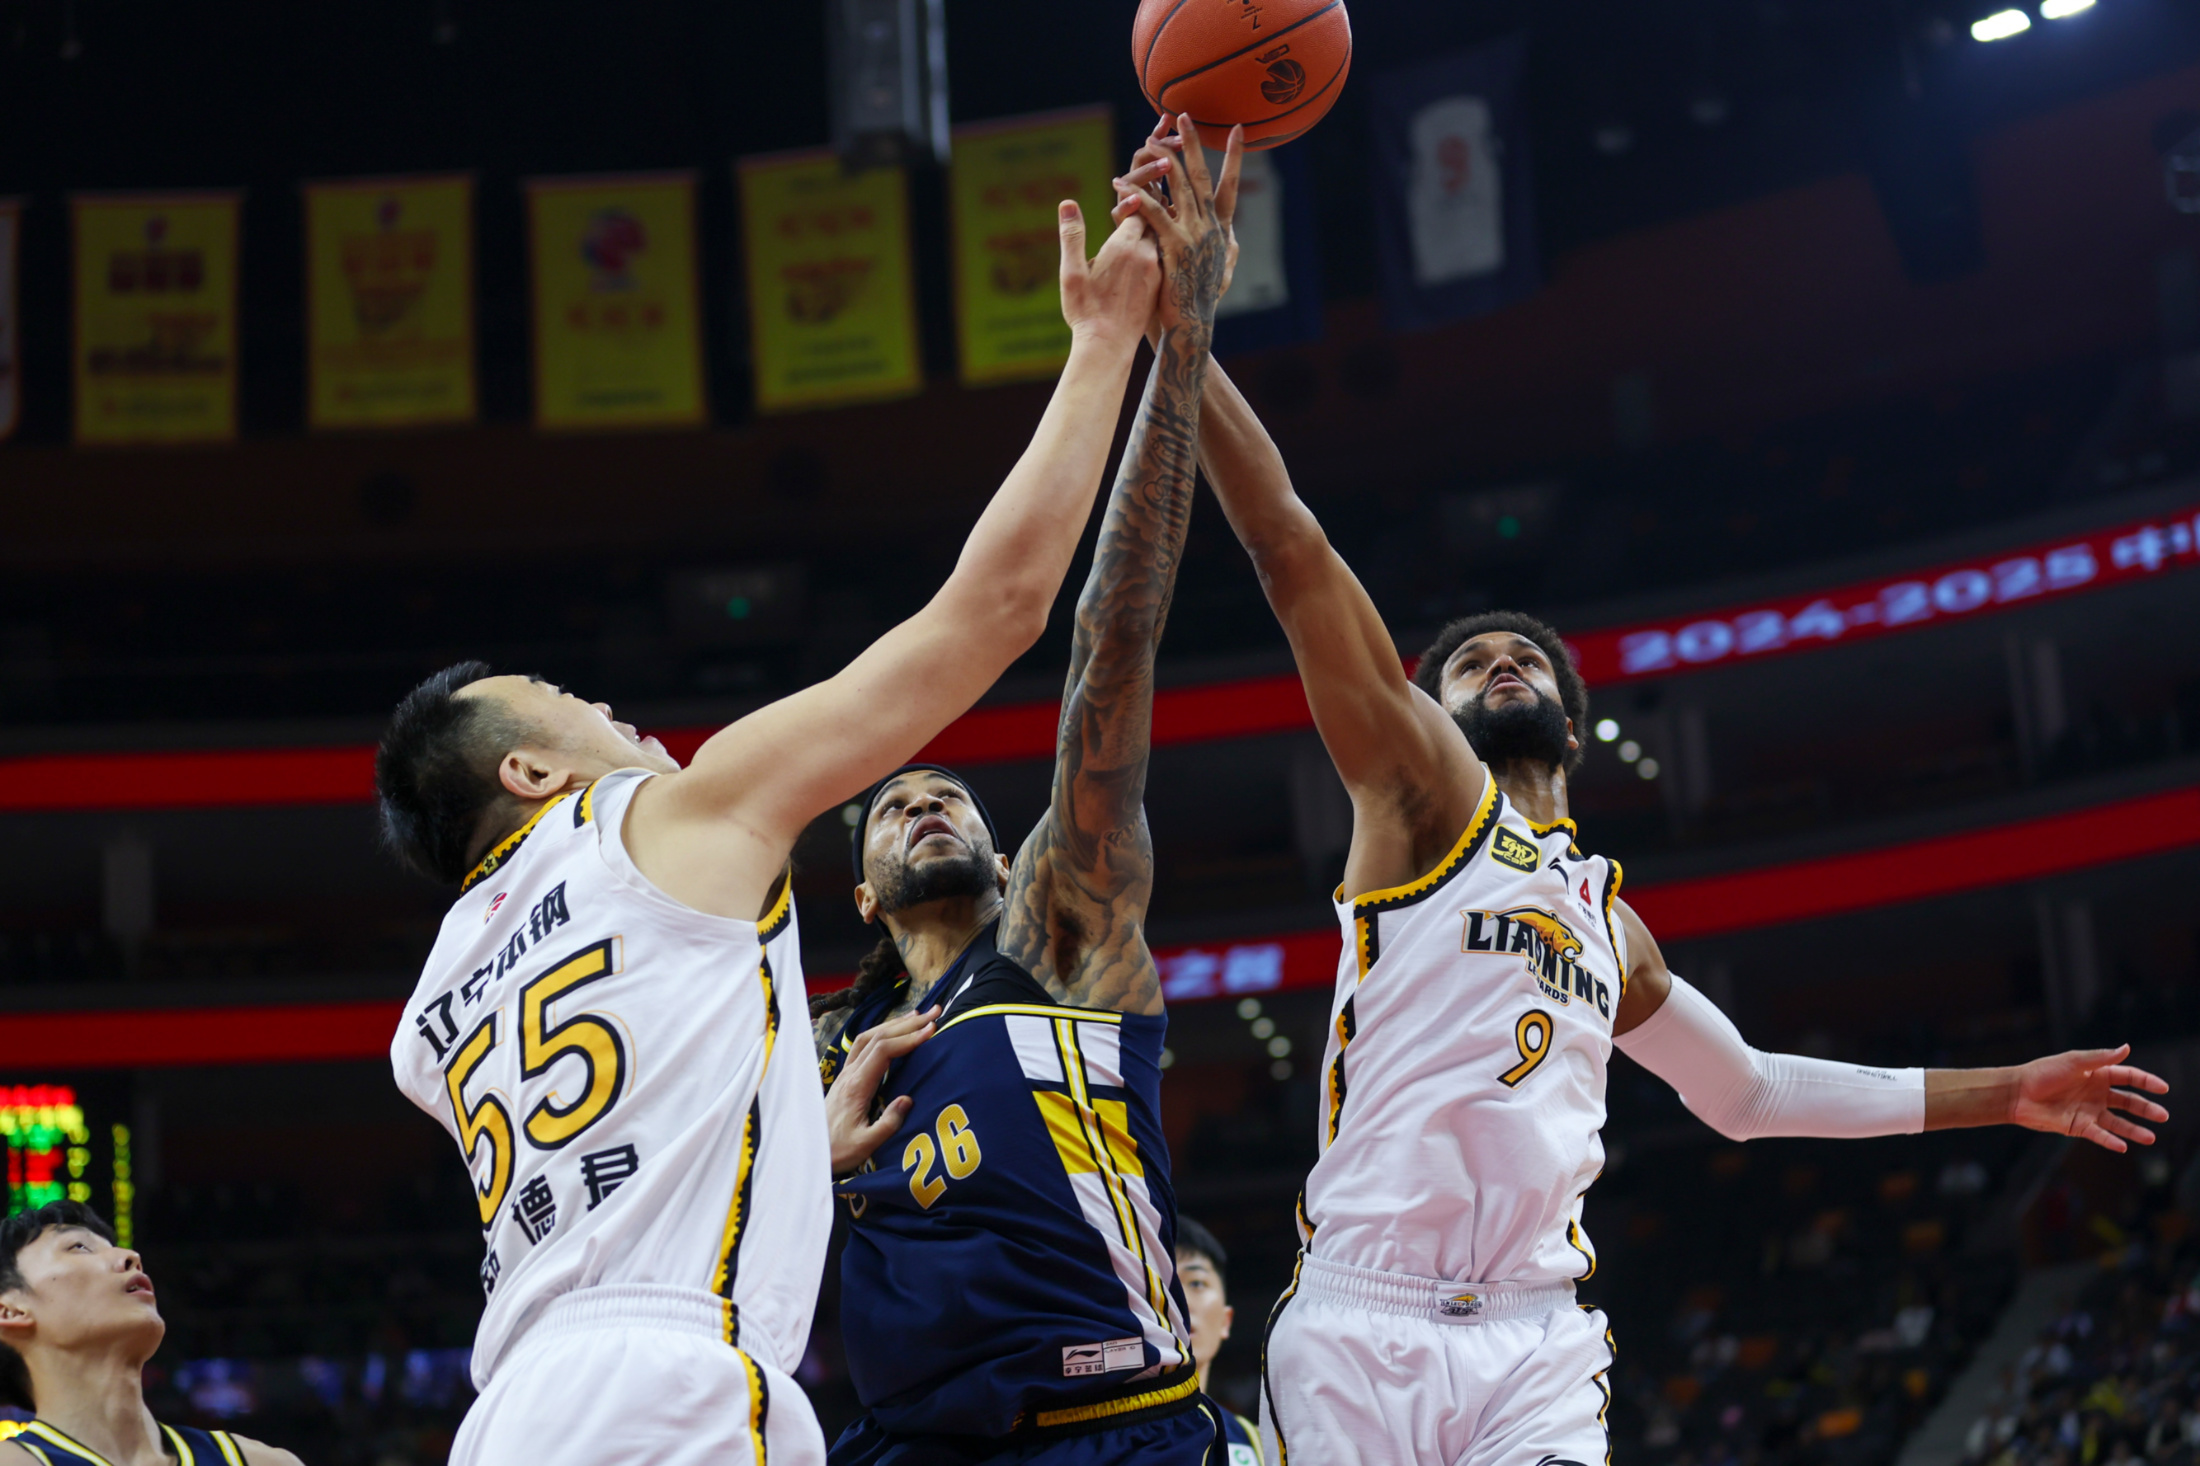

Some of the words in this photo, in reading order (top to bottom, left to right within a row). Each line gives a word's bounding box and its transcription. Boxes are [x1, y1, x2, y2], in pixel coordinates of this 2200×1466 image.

[1619, 543, 2098, 675] 2024-2025
[415, 880, 571, 1065] 辽宁本钢
[1527, 959, 1569, 1004] LEARDS
[444, 935, 632, 1232] 55
[1496, 1008, 1555, 1089] 9
[902, 1103, 982, 1210] 26
